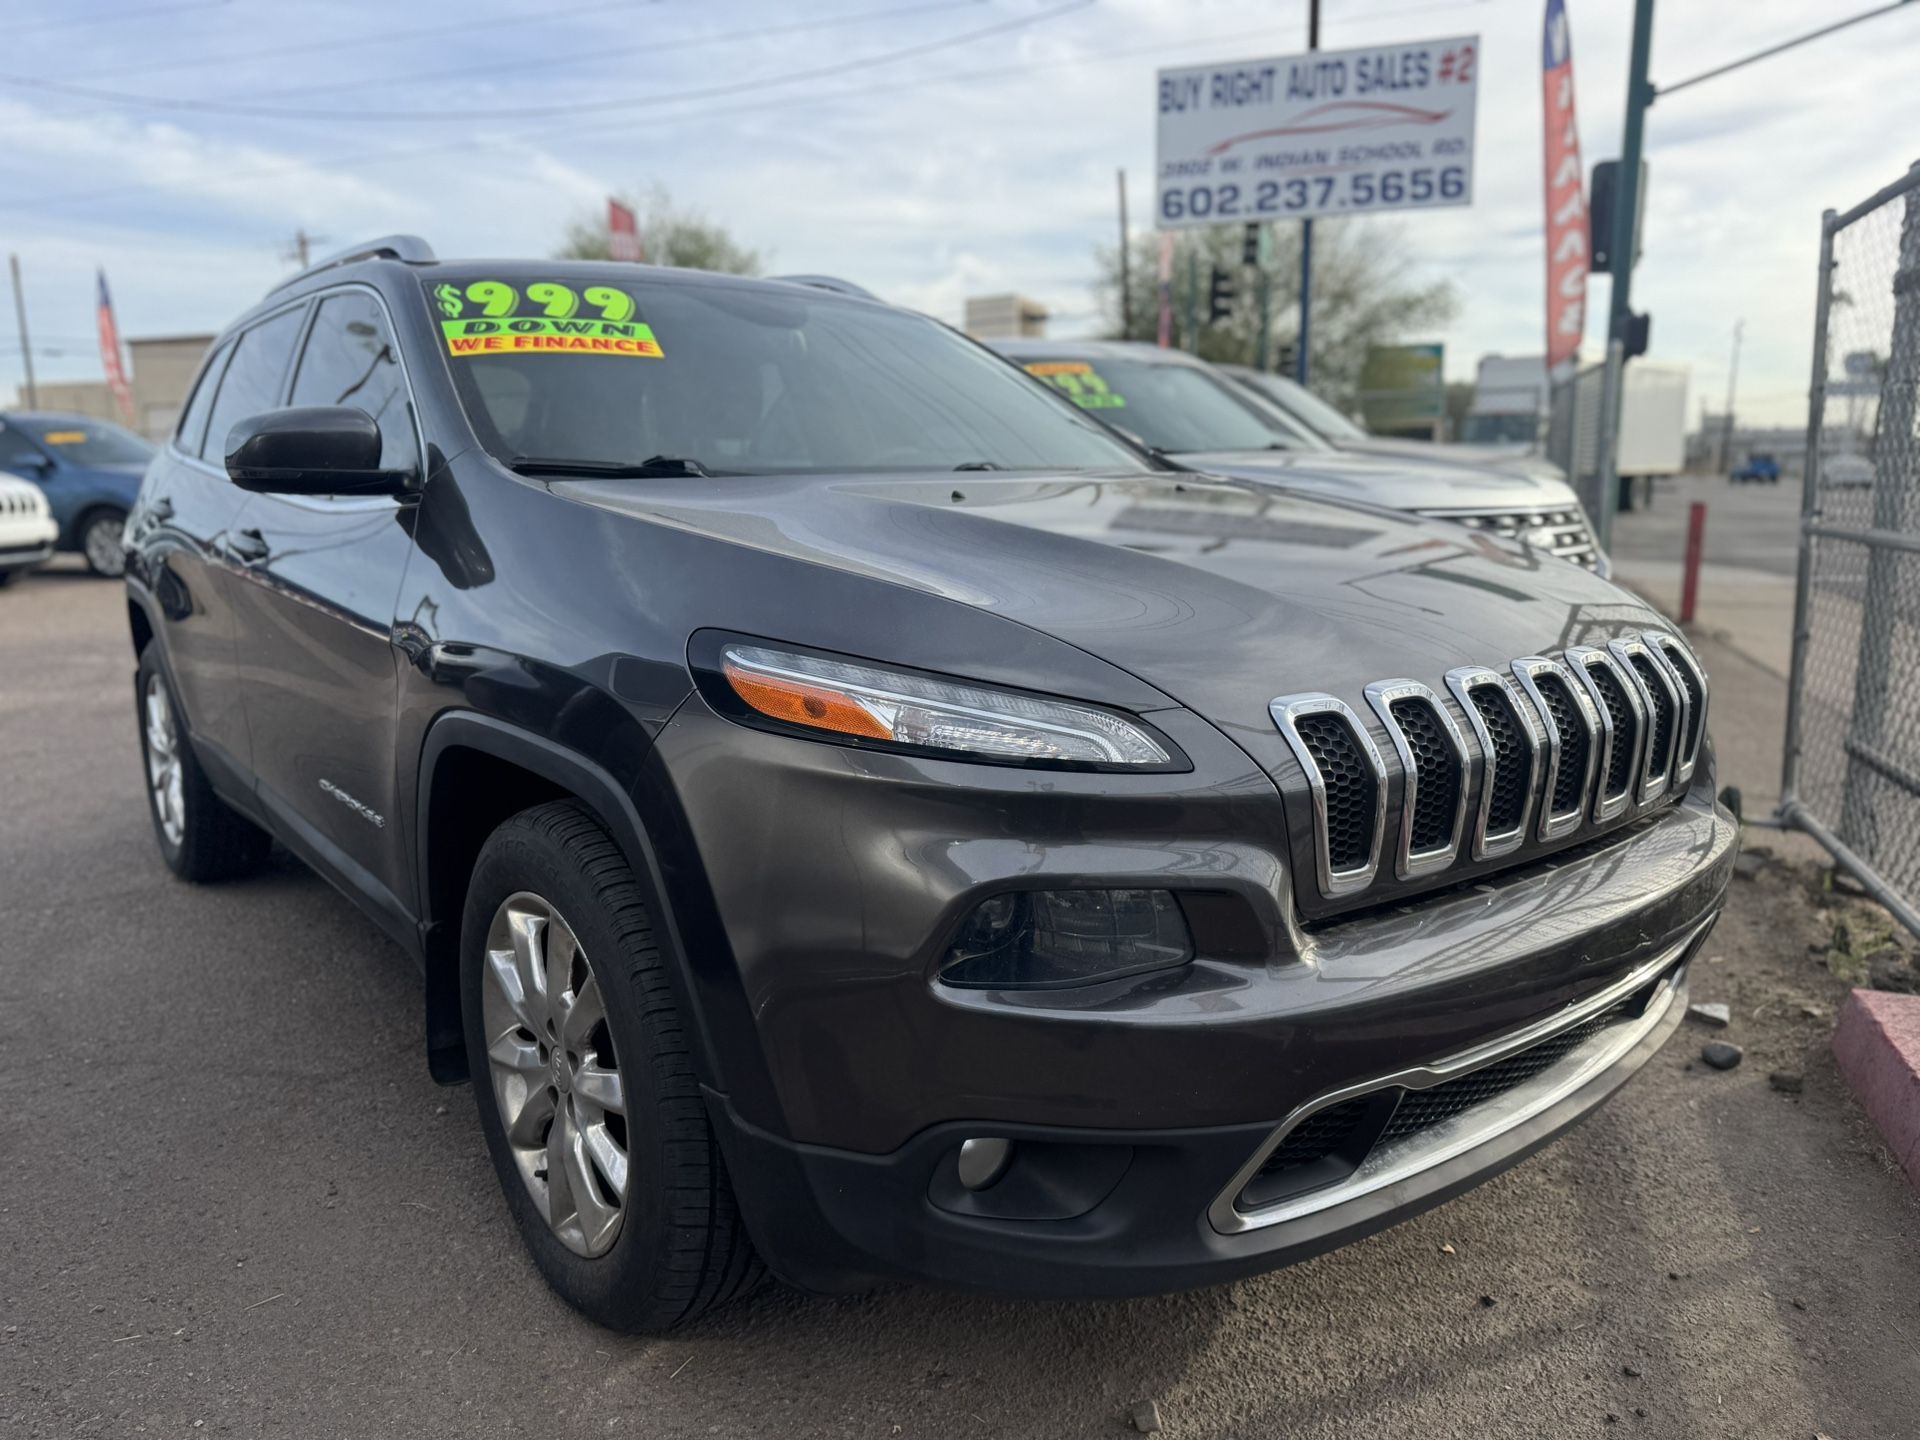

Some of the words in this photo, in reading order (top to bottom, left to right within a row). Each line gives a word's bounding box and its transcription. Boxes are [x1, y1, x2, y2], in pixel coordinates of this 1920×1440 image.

[1159, 73, 1206, 113] BUY
[1210, 67, 1277, 108] RIGHT
[1289, 60, 1346, 99] AUTO
[1356, 51, 1431, 94] SALES
[1438, 45, 1475, 84] #2
[1161, 167, 1466, 220] 602.237.5656
[434, 281, 636, 322] $999
[451, 337, 503, 352] WE
[513, 336, 656, 353] FINANCE
[463, 320, 636, 337] DOWN
